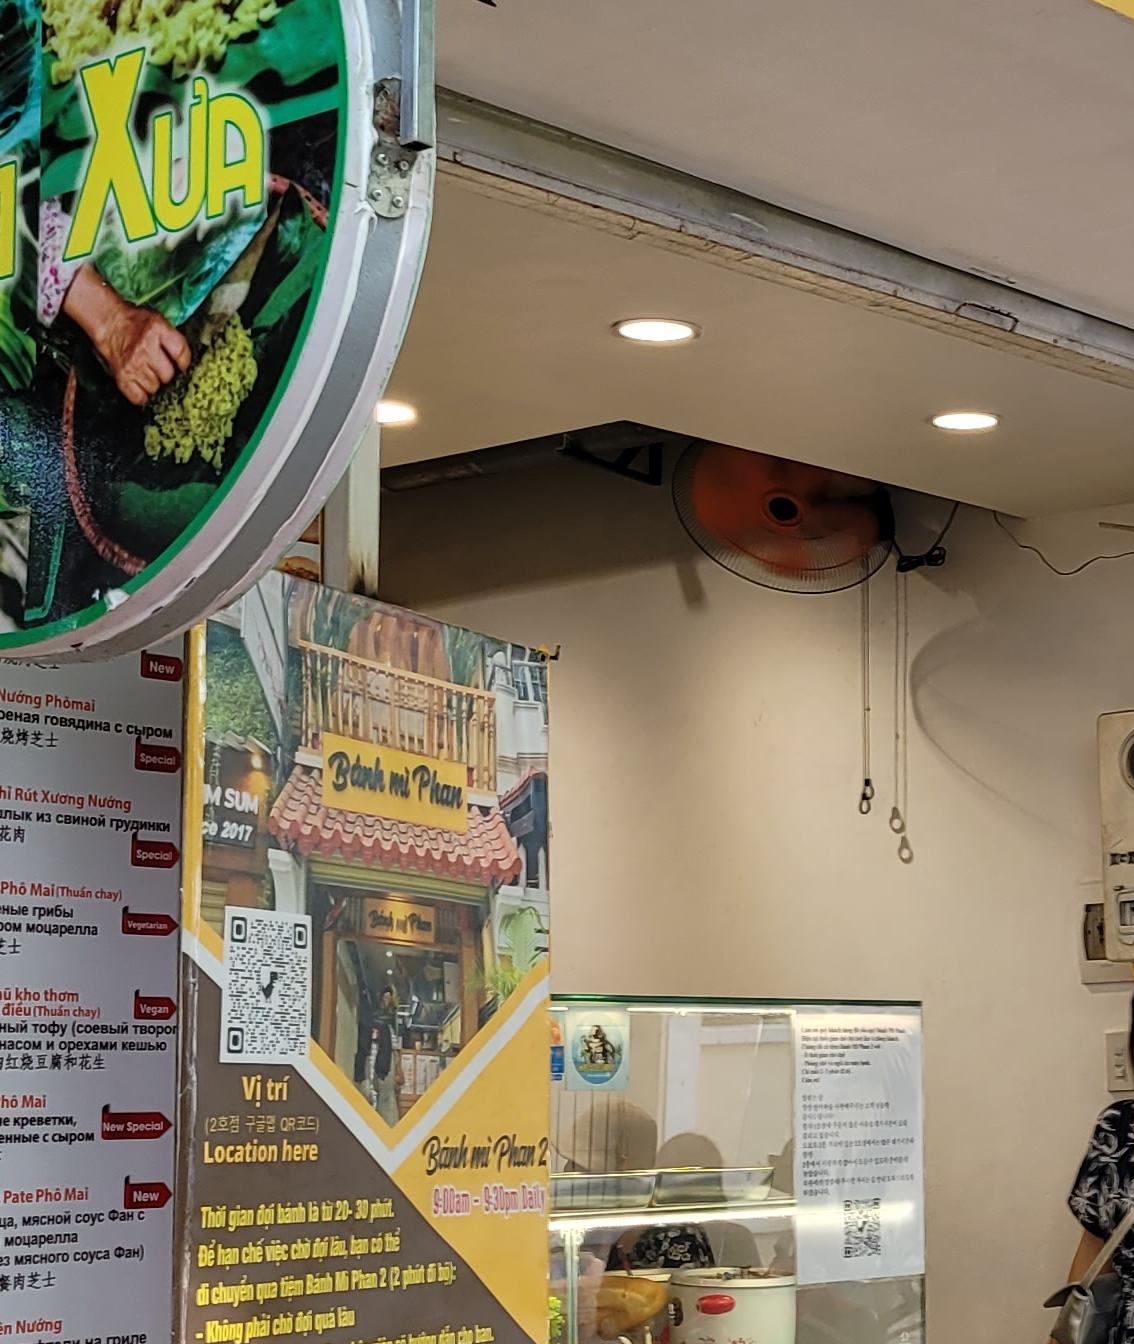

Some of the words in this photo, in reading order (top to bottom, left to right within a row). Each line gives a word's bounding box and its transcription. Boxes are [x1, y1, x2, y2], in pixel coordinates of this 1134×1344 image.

[63, 47, 265, 262] XƯA
[149, 661, 175, 674] New
[45, 715, 111, 733] говядина
[115, 725, 122, 734] с
[127, 725, 173, 740] сыром
[140, 752, 175, 765] Special
[329, 751, 385, 794] Bánh
[388, 767, 411, 799] mì
[414, 765, 463, 809] Phan
[15, 787, 38, 802] Rút
[43, 792, 84, 809] Xương
[88, 794, 131, 812] Nướng
[224, 788, 259, 814] SUM
[37, 813, 51, 822] из
[56, 812, 105, 827] свиной
[110, 819, 170, 832] грудинки
[221, 821, 253, 841] 2017
[137, 850, 173, 861] Special
[31, 883, 55, 896] Mai
[95, 888, 122, 901] chay)
[33, 904, 73, 919] грибы
[26, 923, 98, 937] моцарелла
[128, 921, 167, 930] Vegetarian
[15, 988, 40, 1002] kho
[44, 989, 79, 1003] thơm
[73, 1007, 100, 1020] chay)
[140, 1004, 169, 1015] Vegan
[32, 1022, 67, 1037] тофу
[72, 1021, 129, 1037] (соевый
[46, 1040, 54, 1051] и
[60, 1040, 117, 1055] орехами
[122, 1040, 167, 1051] кешью
[242, 1076, 262, 1107] Vị
[267, 1075, 289, 1101] trí
[22, 1094, 46, 1108] Mai
[13, 1115, 77, 1132] креветки,
[103, 1122, 124, 1132] New
[127, 1121, 163, 1132] Special
[244, 1115, 276, 1133] 구글맵
[52, 1131, 94, 1144] сыром
[203, 1139, 279, 1165] Location
[282, 1141, 319, 1162] here
[423, 1134, 468, 1175] Bánh
[470, 1136, 492, 1169] mì
[494, 1135, 534, 1172] Phan
[538, 1137, 548, 1167] 2
[3, 1191, 33, 1204] Pate
[64, 1187, 89, 1201] Mai
[132, 1190, 159, 1202] New
[521, 1184, 545, 1212] Daily
[22, 1211, 70, 1227] мясной
[75, 1211, 104, 1226] соус
[108, 1209, 133, 1223] Фан
[201, 1204, 226, 1229] Thời
[229, 1205, 254, 1232] gian
[256, 1203, 274, 1230] đợi
[277, 1201, 305, 1224] bánh
[308, 1201, 319, 1221] là
[356, 1200, 368, 1220] 30
[4, 1232, 78, 1249] моцарелла
[15, 1251, 69, 1267] мясного
[74, 1249, 110, 1265] соуса
[114, 1245, 144, 1262] Фан)
[16, 1317, 63, 1335] Nướng
